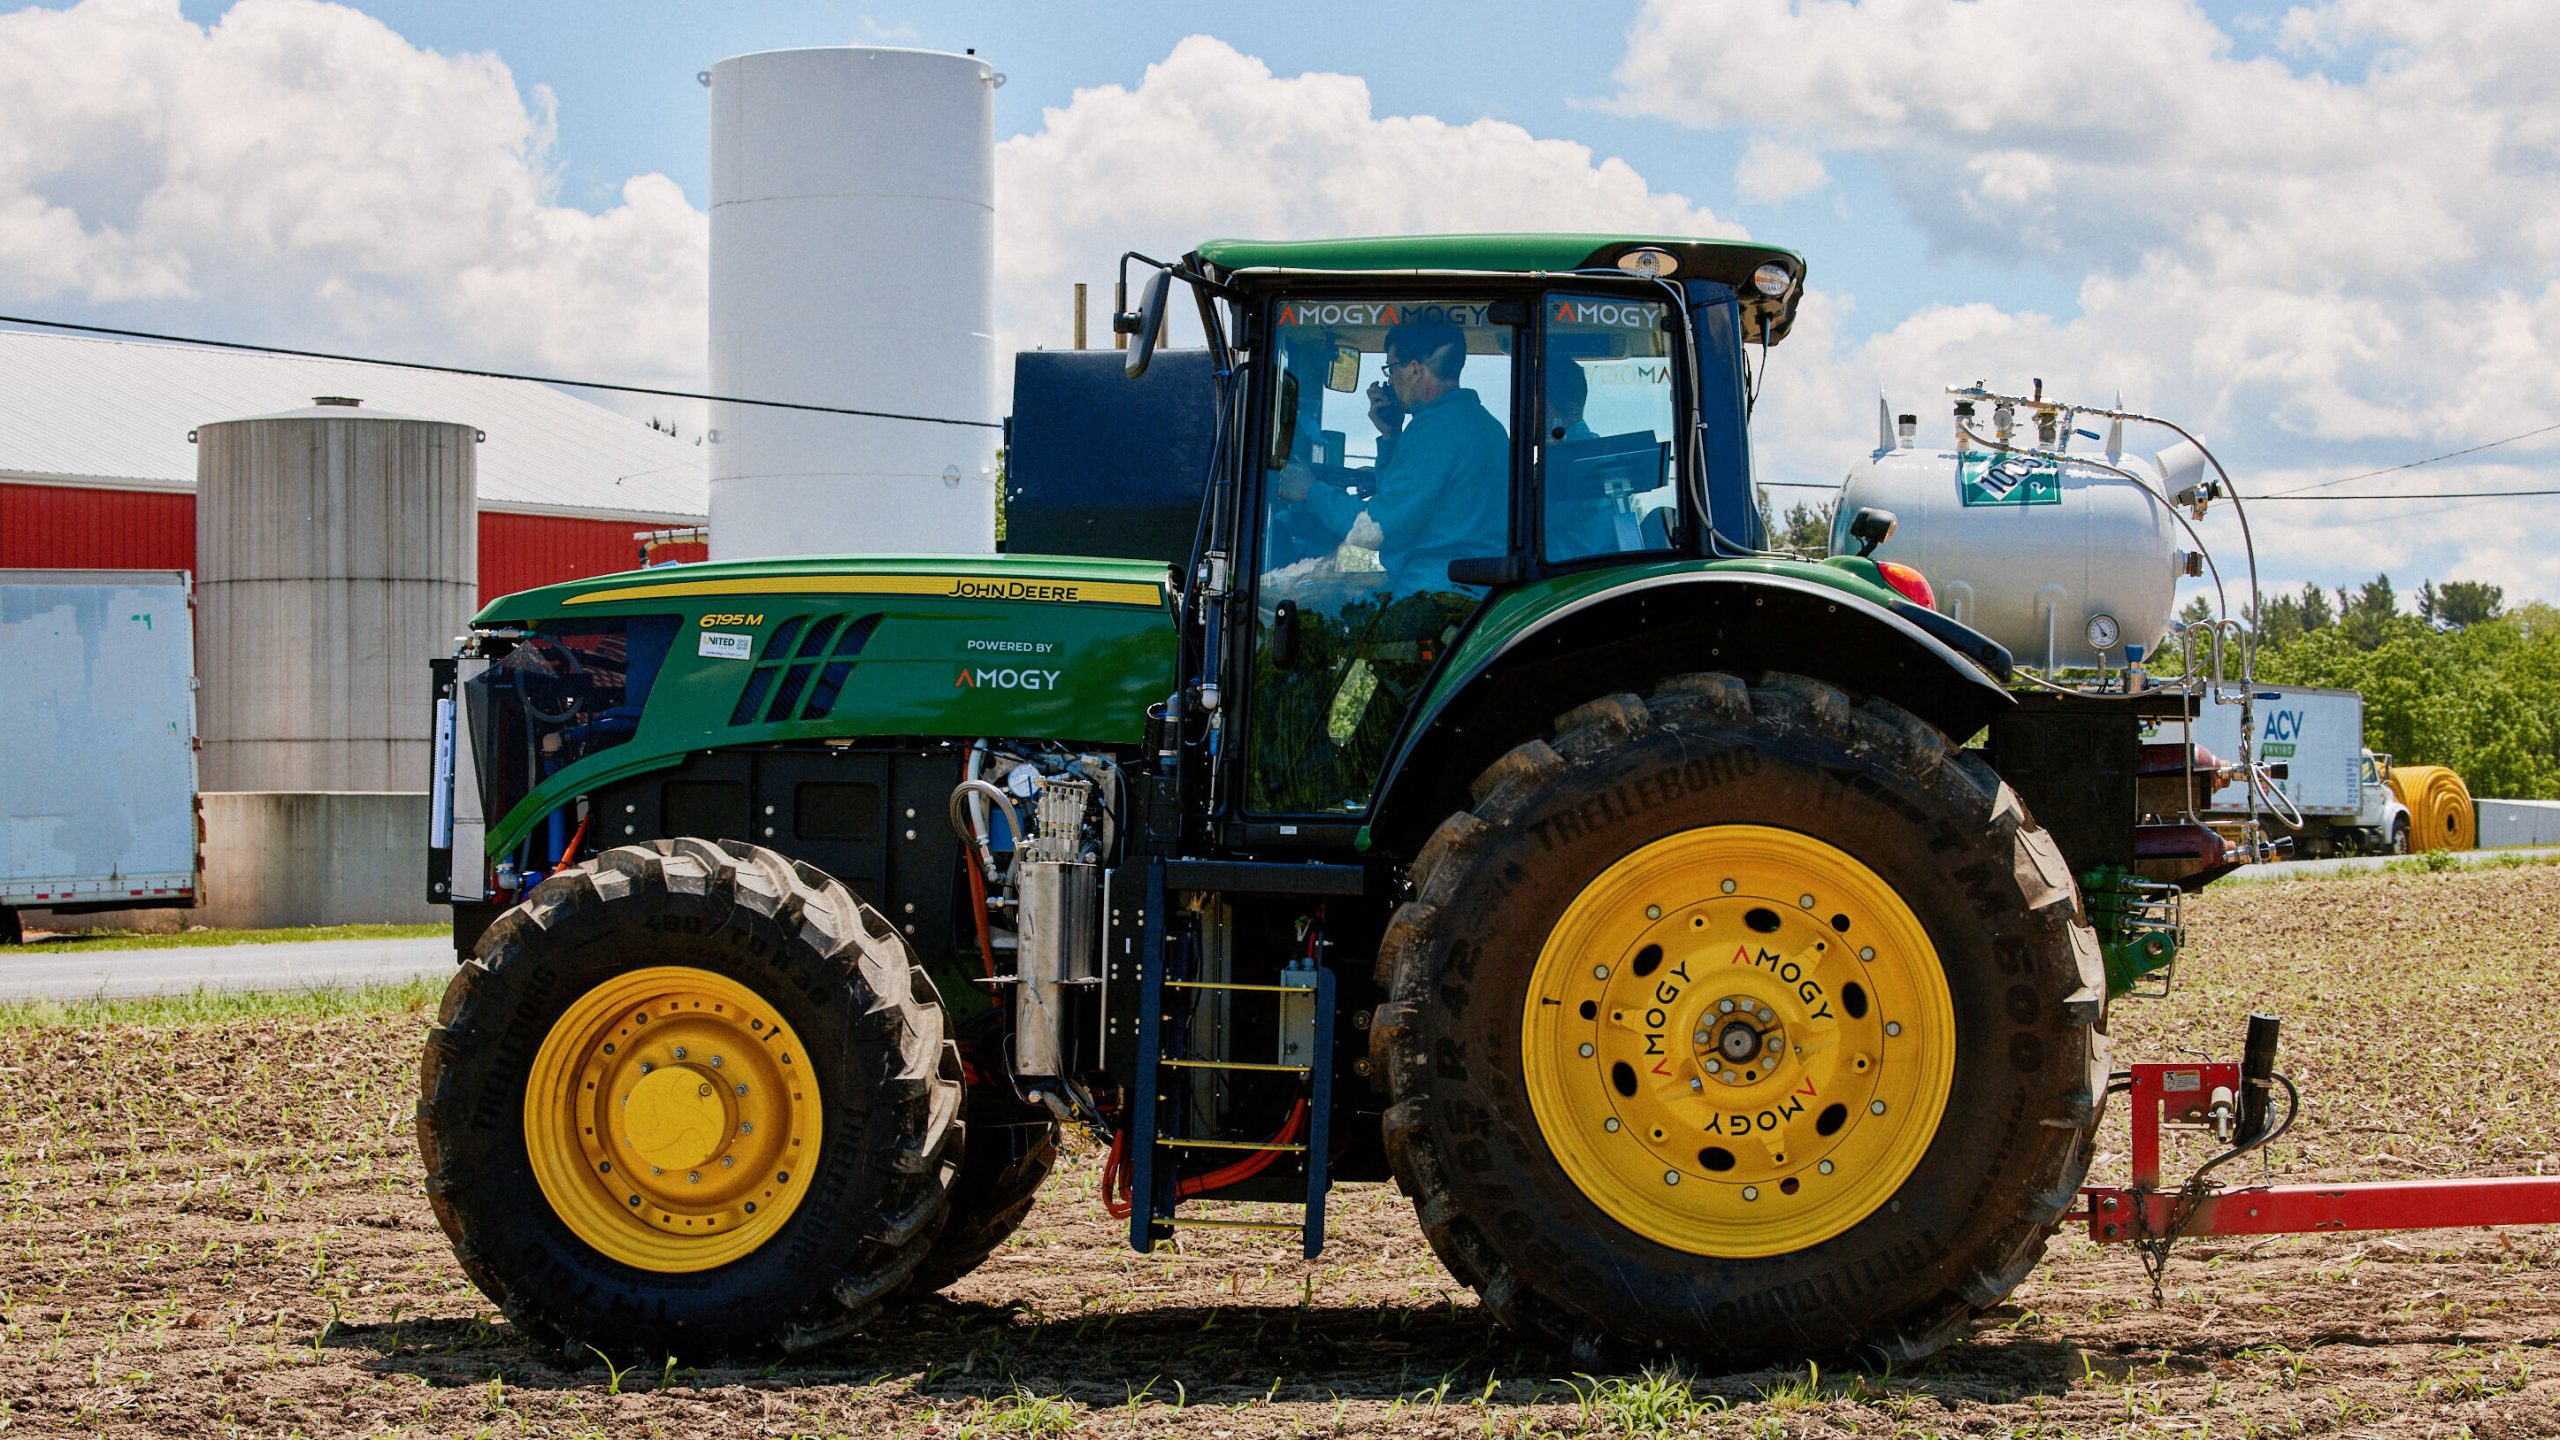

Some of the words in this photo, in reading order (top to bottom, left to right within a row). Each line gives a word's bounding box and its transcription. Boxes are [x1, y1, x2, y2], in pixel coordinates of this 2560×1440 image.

[1279, 304, 1384, 326] AMOGY
[1380, 304, 1487, 327] AMOGY
[1557, 301, 1659, 329] AMOGY
[2029, 481, 2047, 495] 2
[948, 579, 1006, 597] JOHN
[1008, 582, 1079, 601] DEERE
[699, 613, 746, 628] 6195
[745, 613, 764, 626] M
[967, 640, 1033, 652] POWERED
[1036, 643, 1053, 653] BY
[955, 668, 1061, 691] AMOGY
[2263, 709, 2304, 741] ACV
[1731, 944, 1833, 1019] AMOGY
[1645, 960, 1691, 1076] AMOGY
[1704, 1076, 1817, 1136] AMOGY
